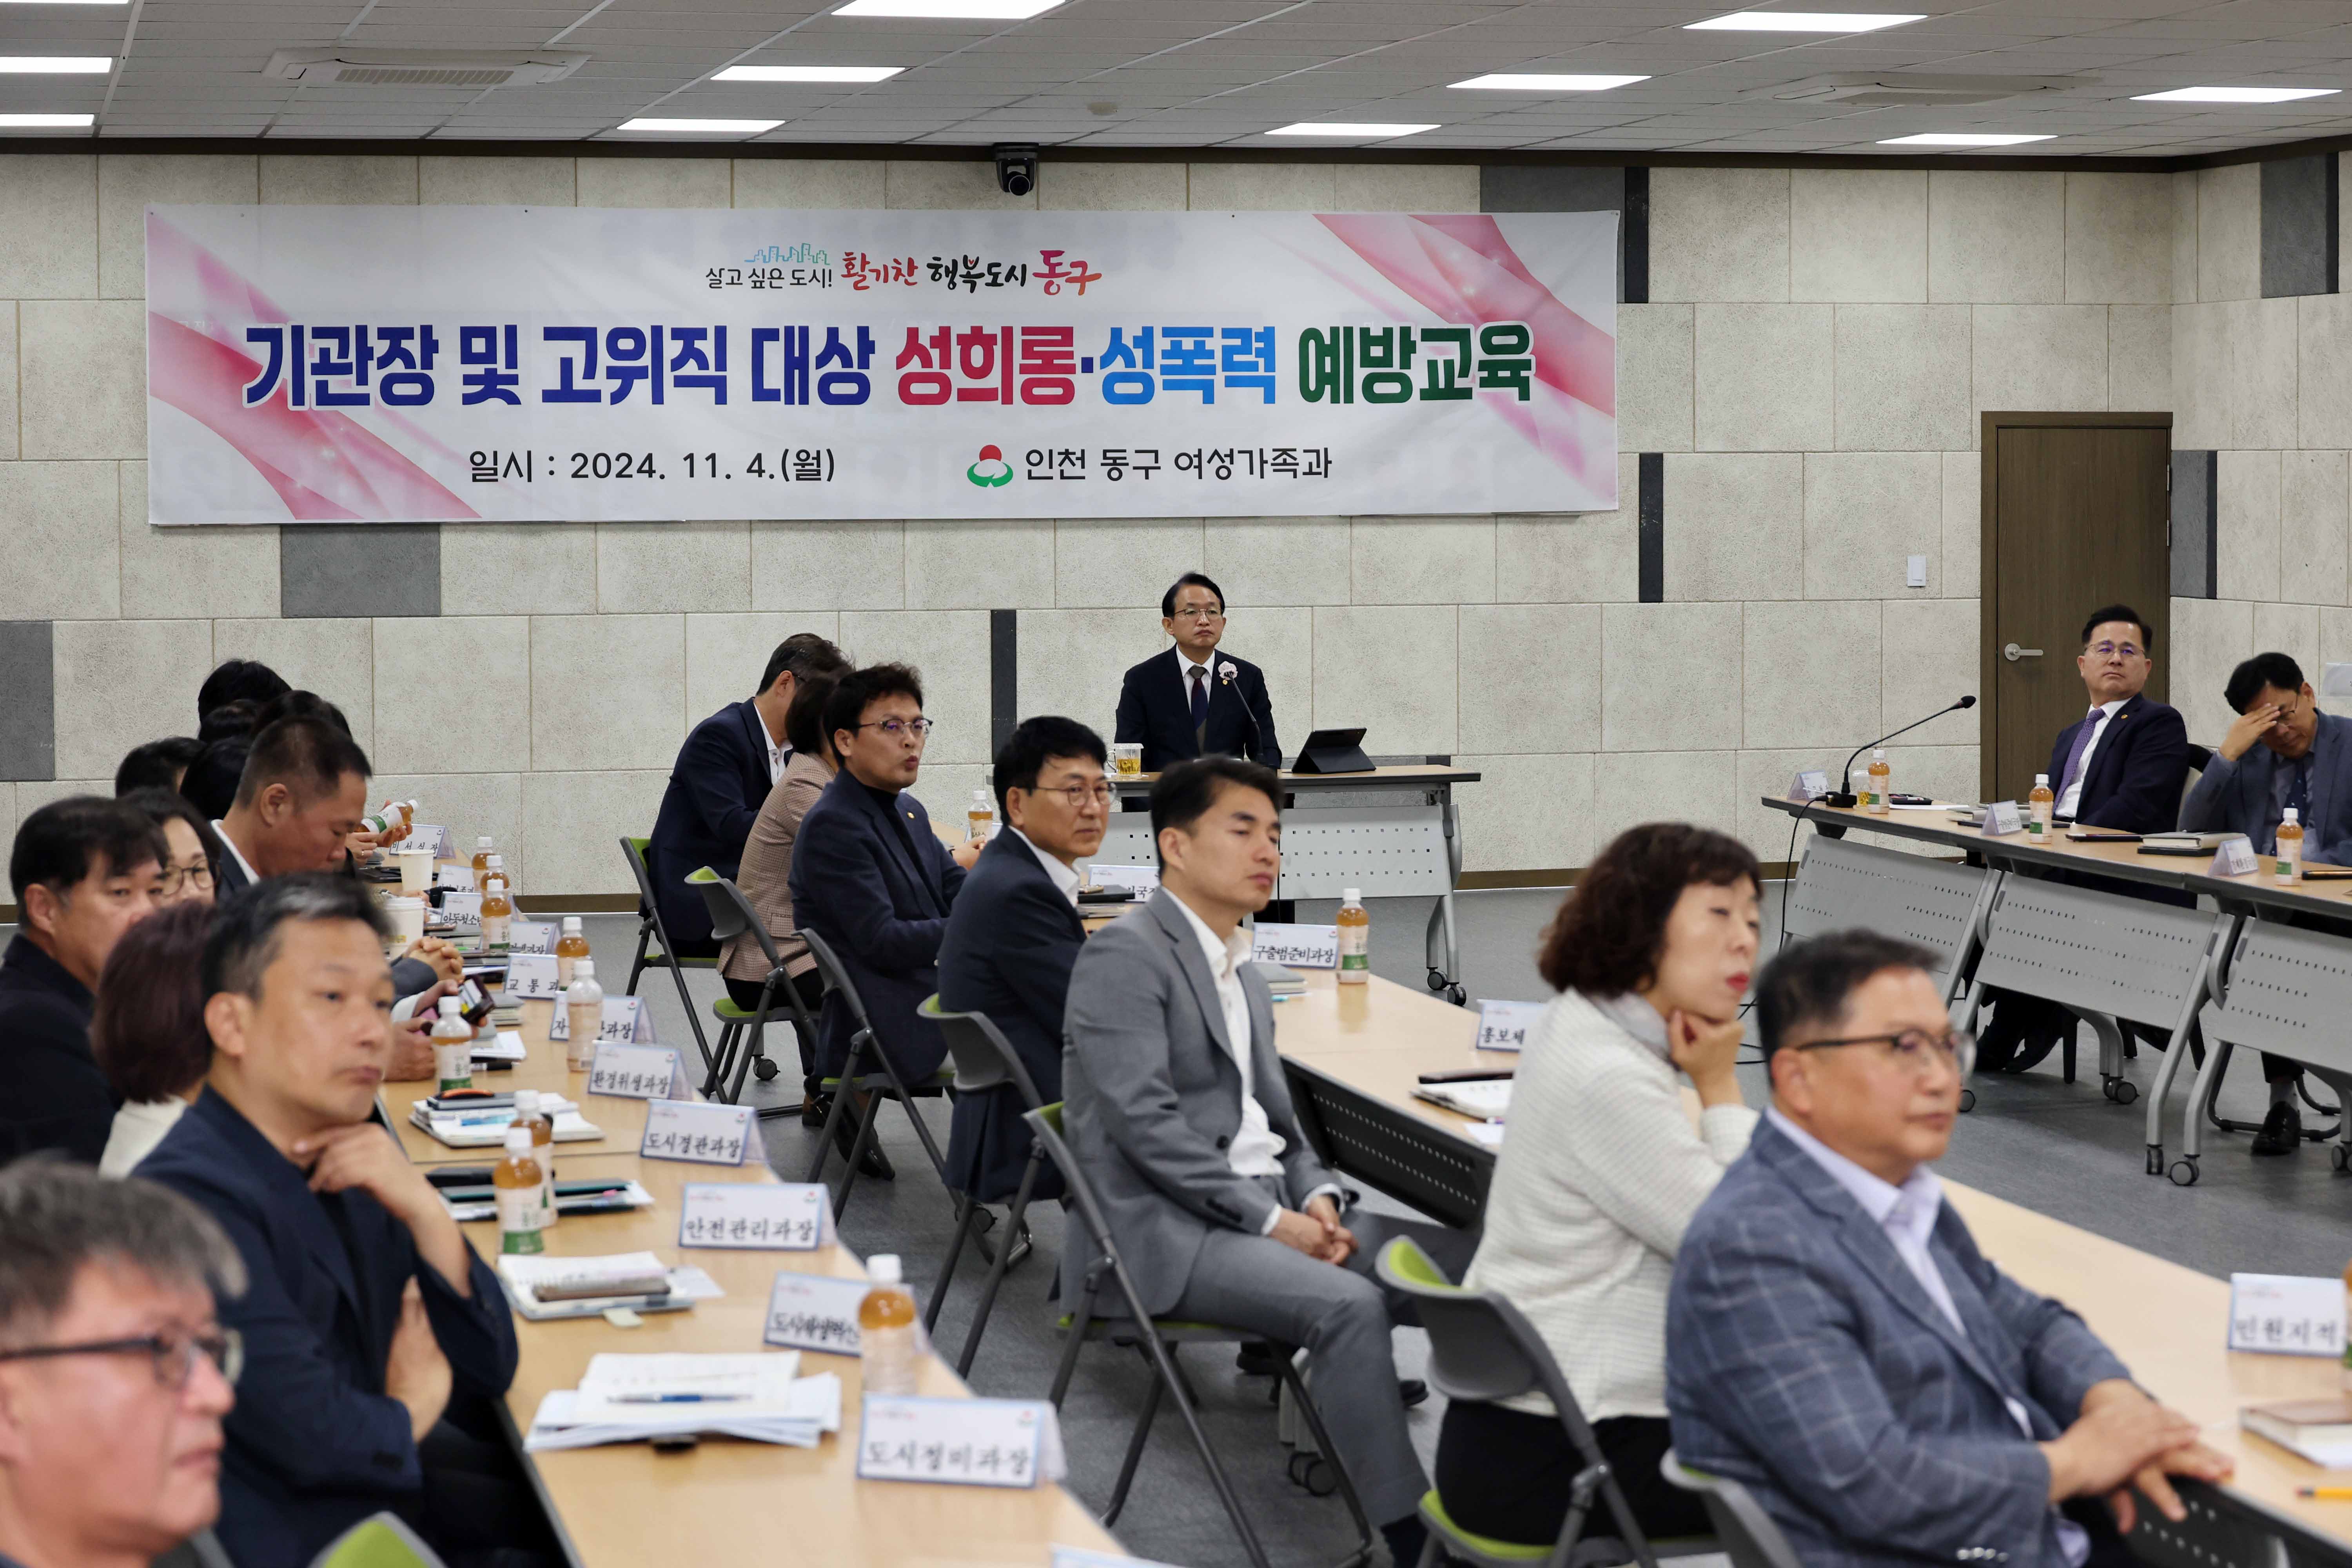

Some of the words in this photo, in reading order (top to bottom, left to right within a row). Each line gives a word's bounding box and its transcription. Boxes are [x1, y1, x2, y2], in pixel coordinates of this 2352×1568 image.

[706, 268, 743, 289] 살고
[748, 268, 785, 289] 싶은
[789, 268, 832, 289] 도시!
[840, 251, 919, 291] 활기찬
[926, 254, 1027, 294] 행복도시
[1032, 250, 1102, 296] 동구
[245, 325, 439, 406] 기관장
[460, 325, 521, 405] 및
[542, 325, 727, 405] 고위직
[751, 326, 875, 405] 대상
[1299, 325, 1531, 404] 예방교육
[470, 450, 532, 483] 일시
[548, 456, 555, 475] :
[571, 452, 665, 479] 2024.
[683, 453, 731, 479] 11.
[746, 448, 834, 482] 4.(월)
[1026, 448, 1085, 480] 인천
[1100, 449, 1161, 481] 동구
[1174, 447, 1332, 480] 여성가족과
[1254, 945, 1335, 963] 구출범준비과장
[593, 1070, 668, 1094] 환경위생과장
[645, 1132, 740, 1158] 도시경관과장
[686, 1216, 814, 1241] 안전관리과장
[864, 1439, 1030, 1476] 도시정비과장
